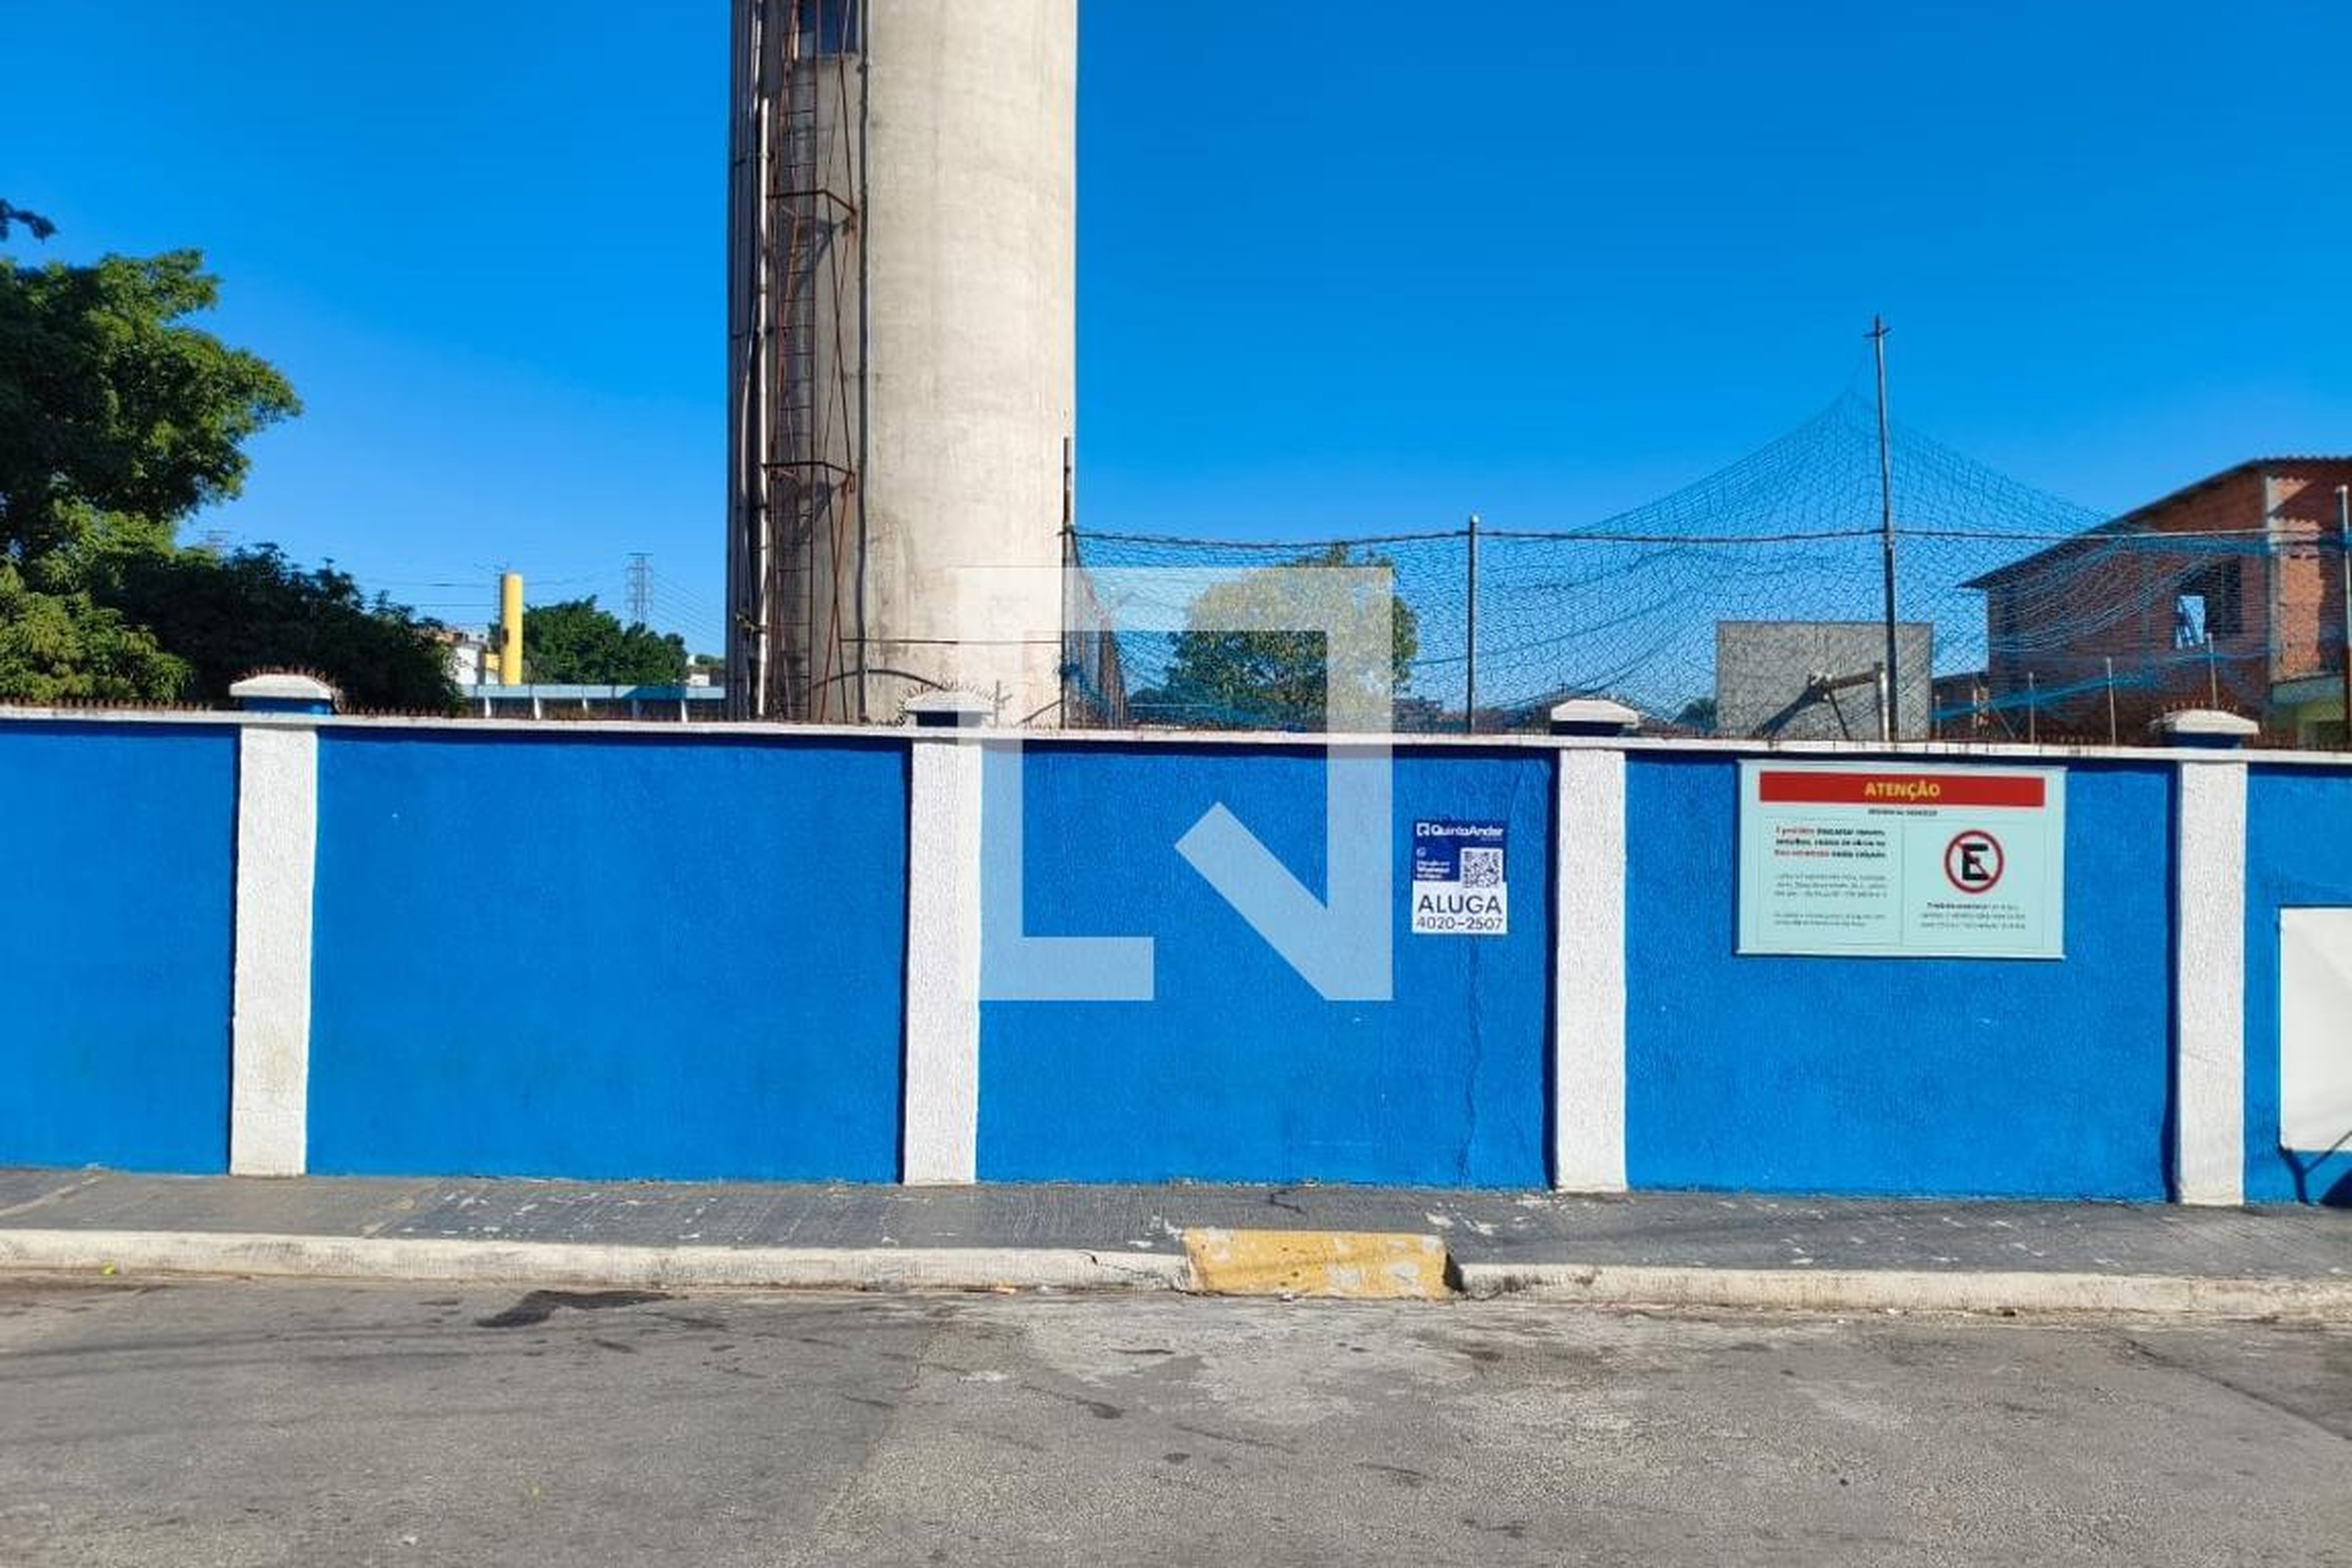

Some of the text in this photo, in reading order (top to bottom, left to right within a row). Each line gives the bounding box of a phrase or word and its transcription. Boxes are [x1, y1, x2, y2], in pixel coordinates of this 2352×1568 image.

[1864, 779, 1940, 801] ATENÇÃO
[1431, 824, 1503, 837] QuintoAndar
[1418, 894, 1502, 914] ALUGA
[1417, 916, 1502, 930] 4020-2507
